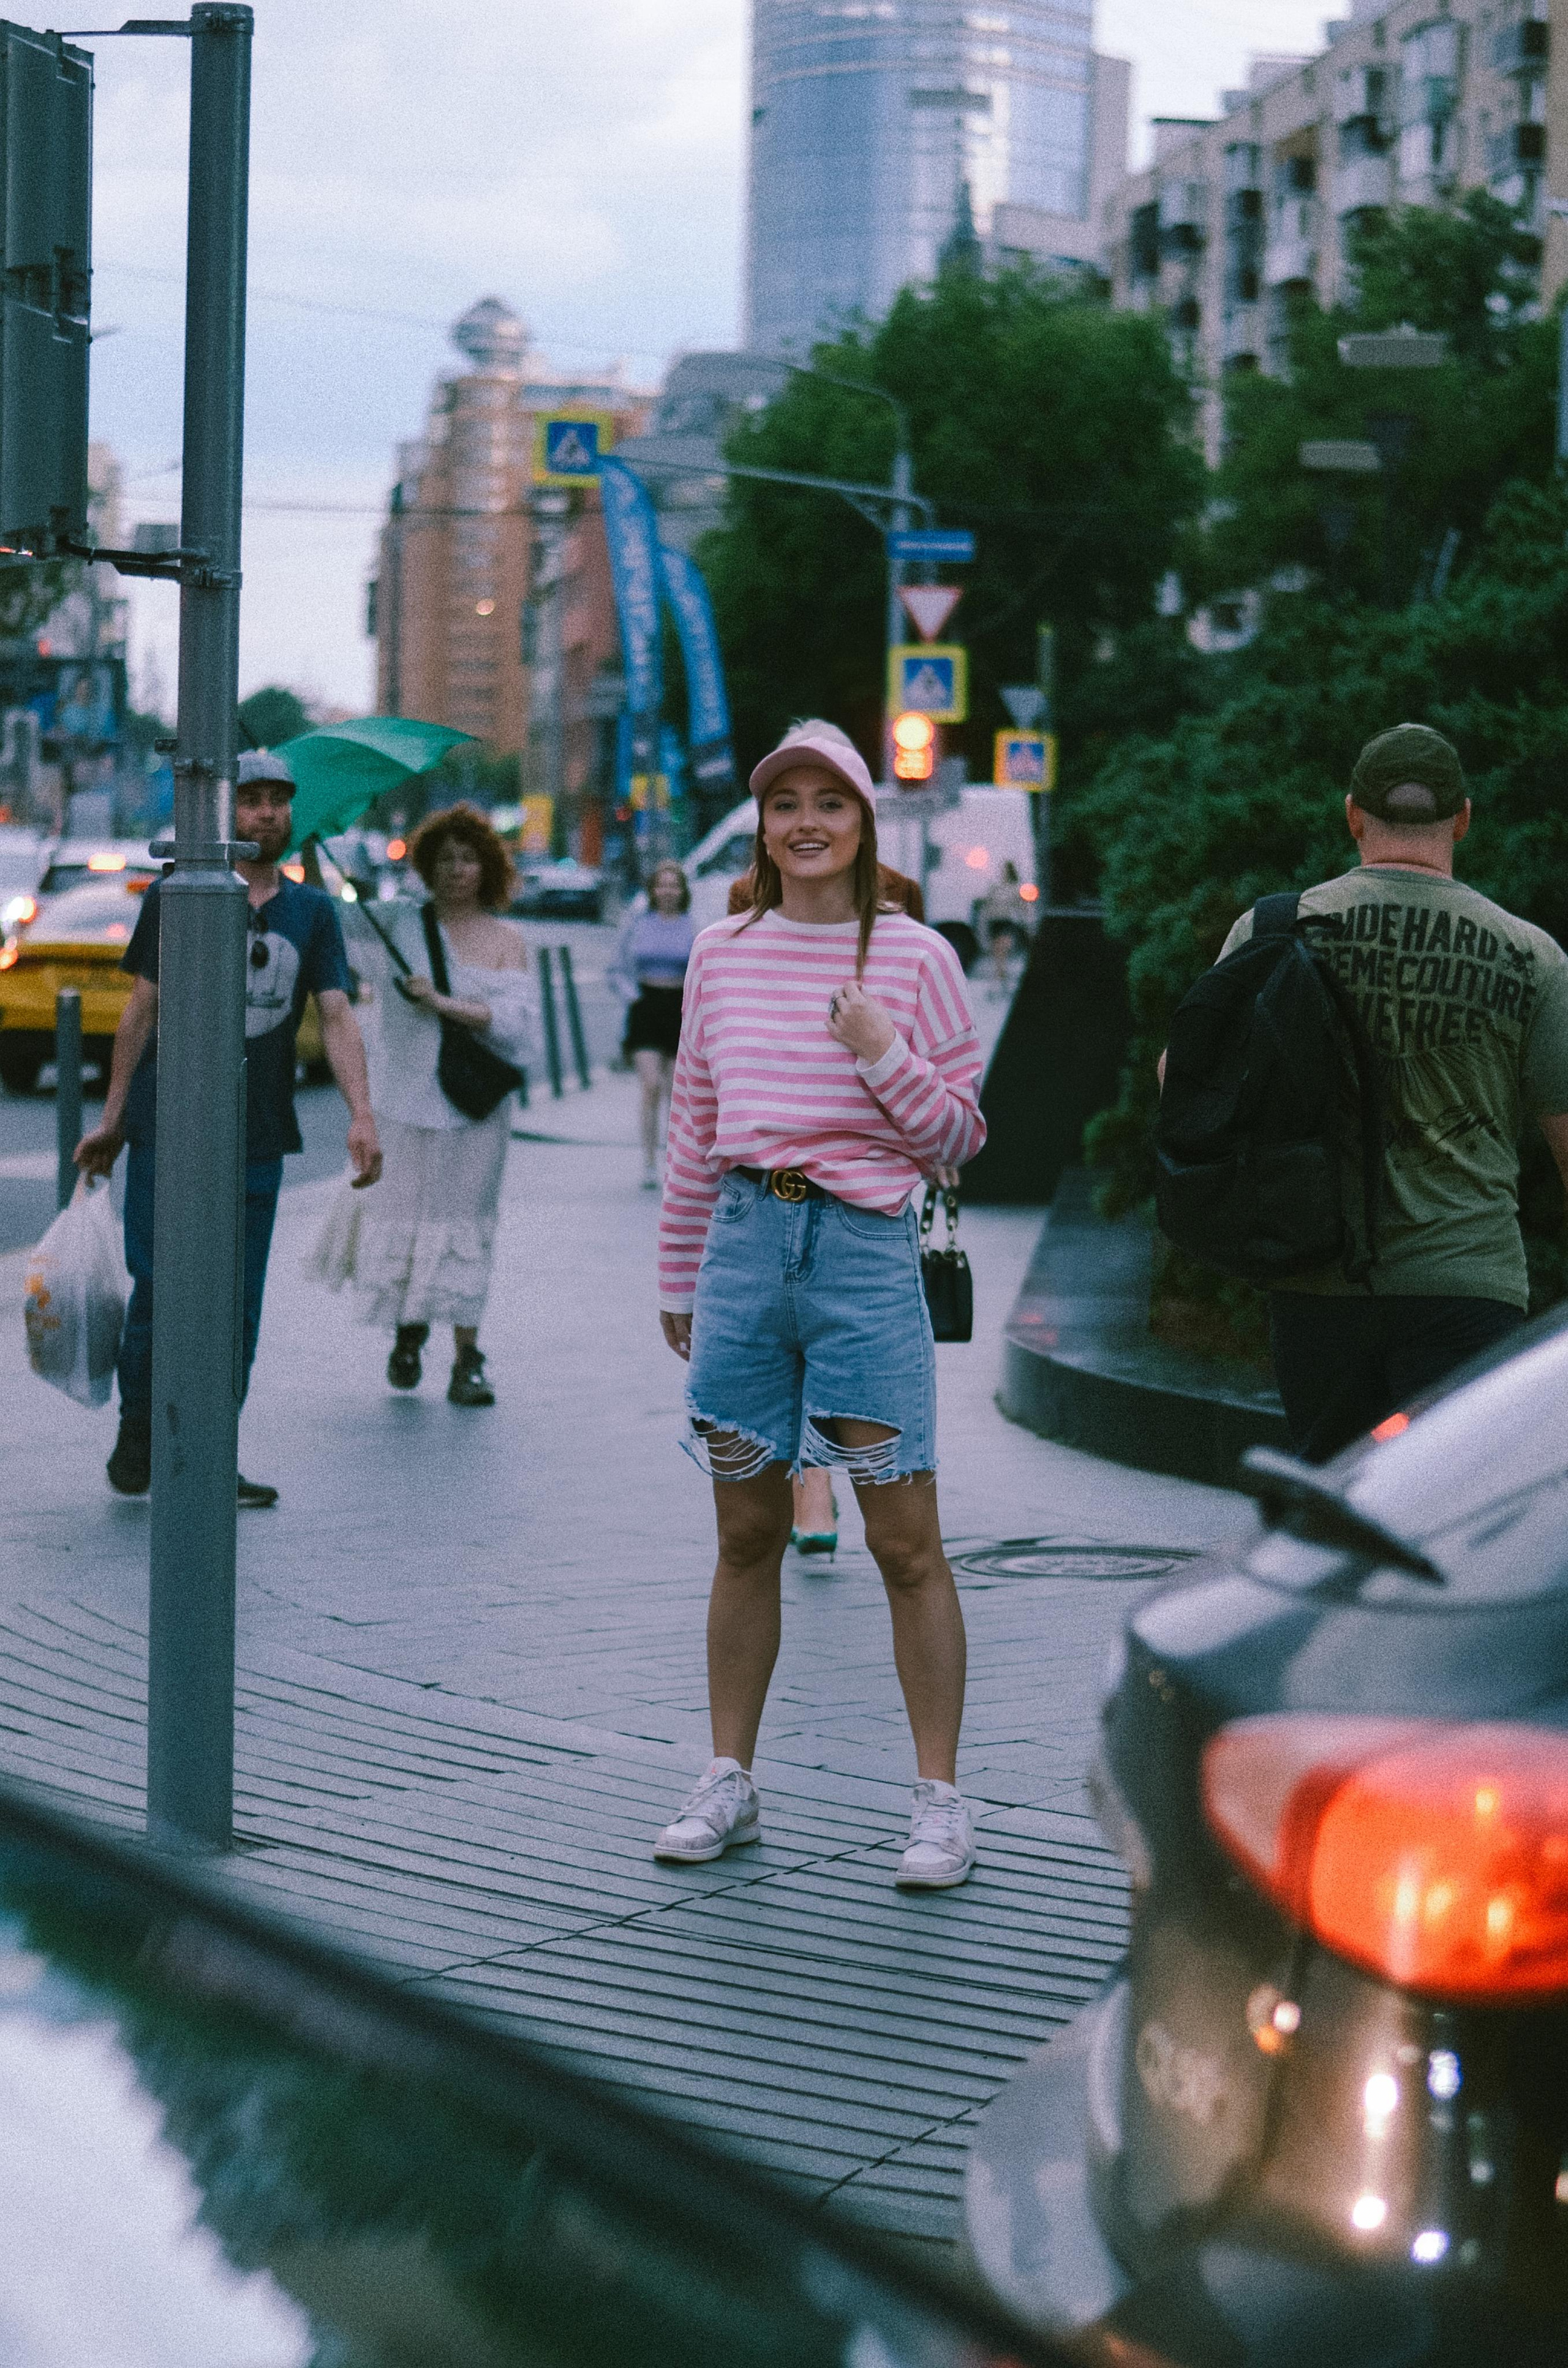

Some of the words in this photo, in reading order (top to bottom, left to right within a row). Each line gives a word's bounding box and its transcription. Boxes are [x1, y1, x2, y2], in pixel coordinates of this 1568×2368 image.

[1401, 906, 1498, 961] HARD
[1396, 956, 1537, 1025] COUTURE
[1399, 997, 1488, 1052] FREE
